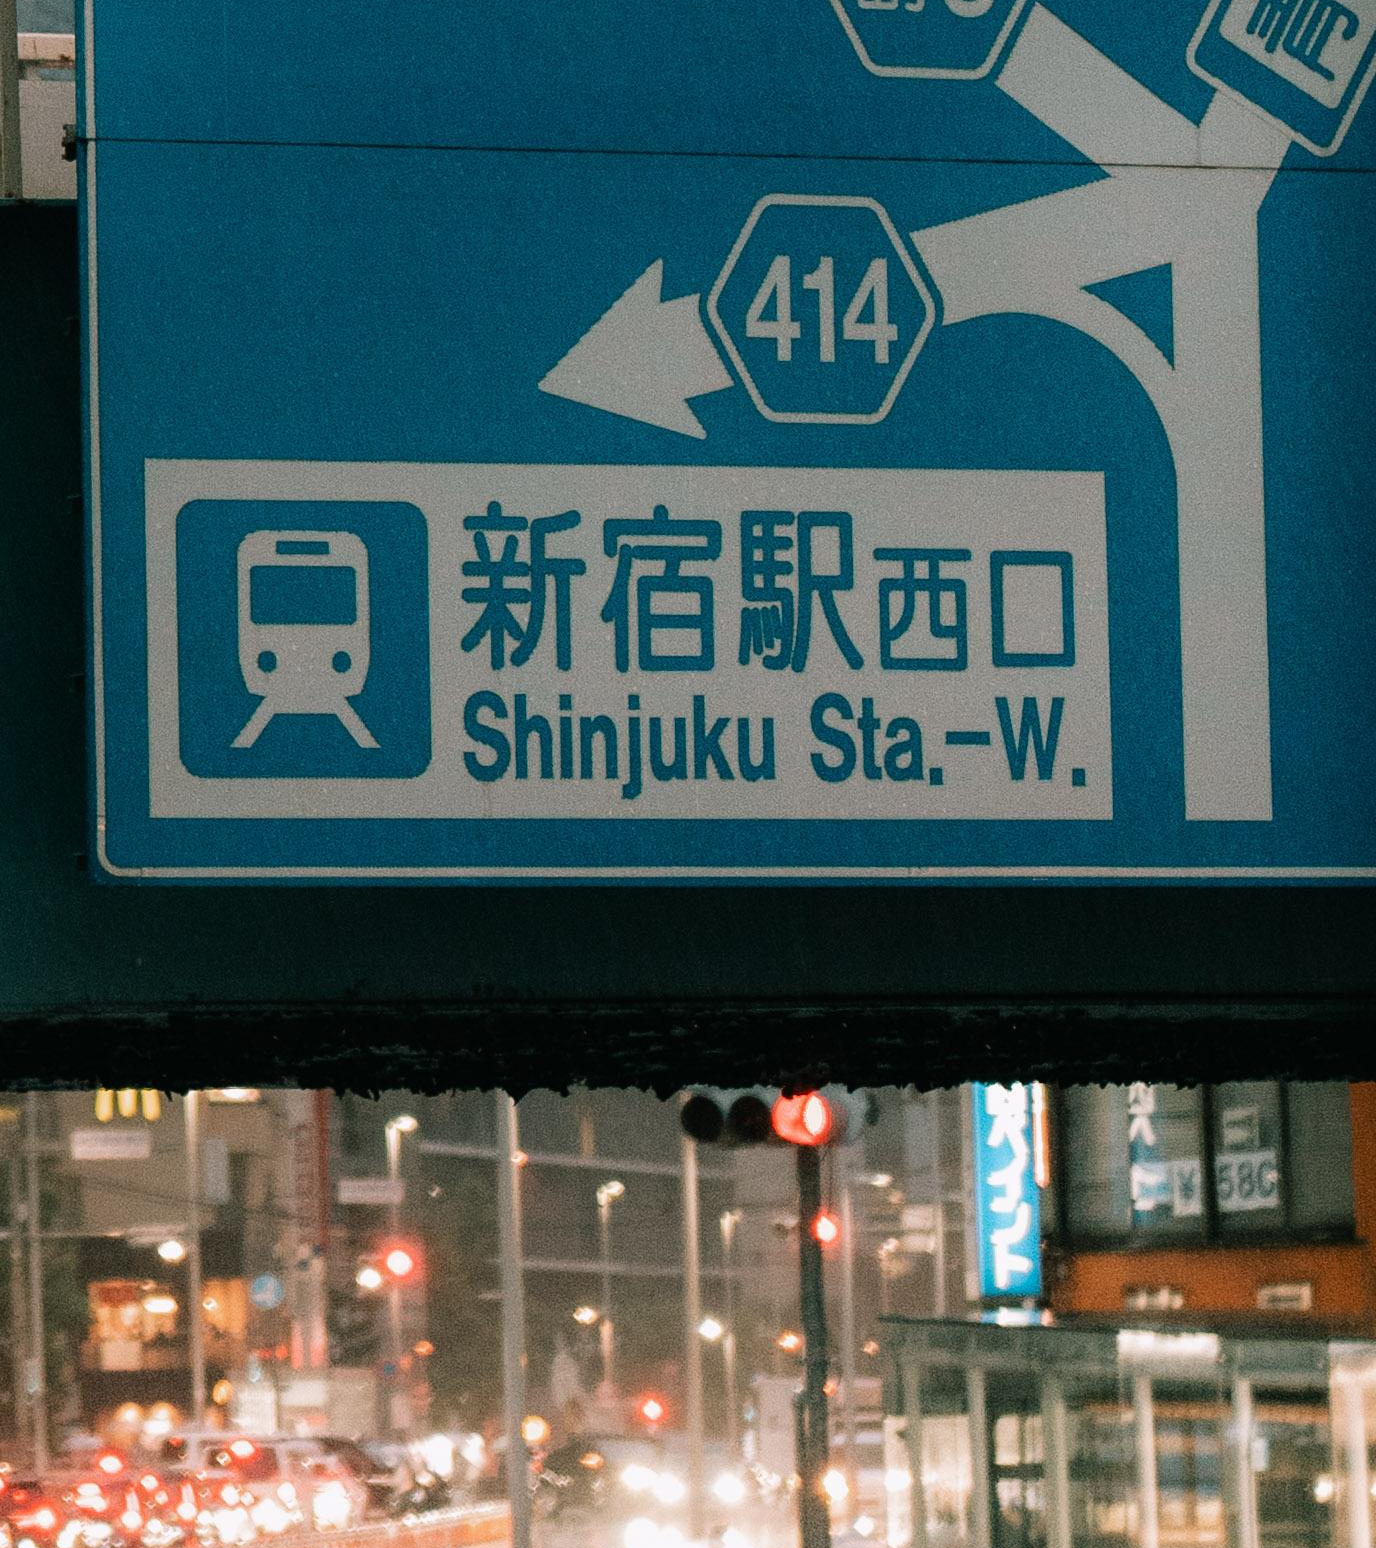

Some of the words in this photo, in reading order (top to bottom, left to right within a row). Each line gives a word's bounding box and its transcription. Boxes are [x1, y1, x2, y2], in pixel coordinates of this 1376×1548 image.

[746, 256, 897, 363] 414
[460, 501, 1075, 673] 新宿駅西口
[463, 690, 775, 800] Shinjuku
[810, 692, 1086, 787] Sta.-W.
